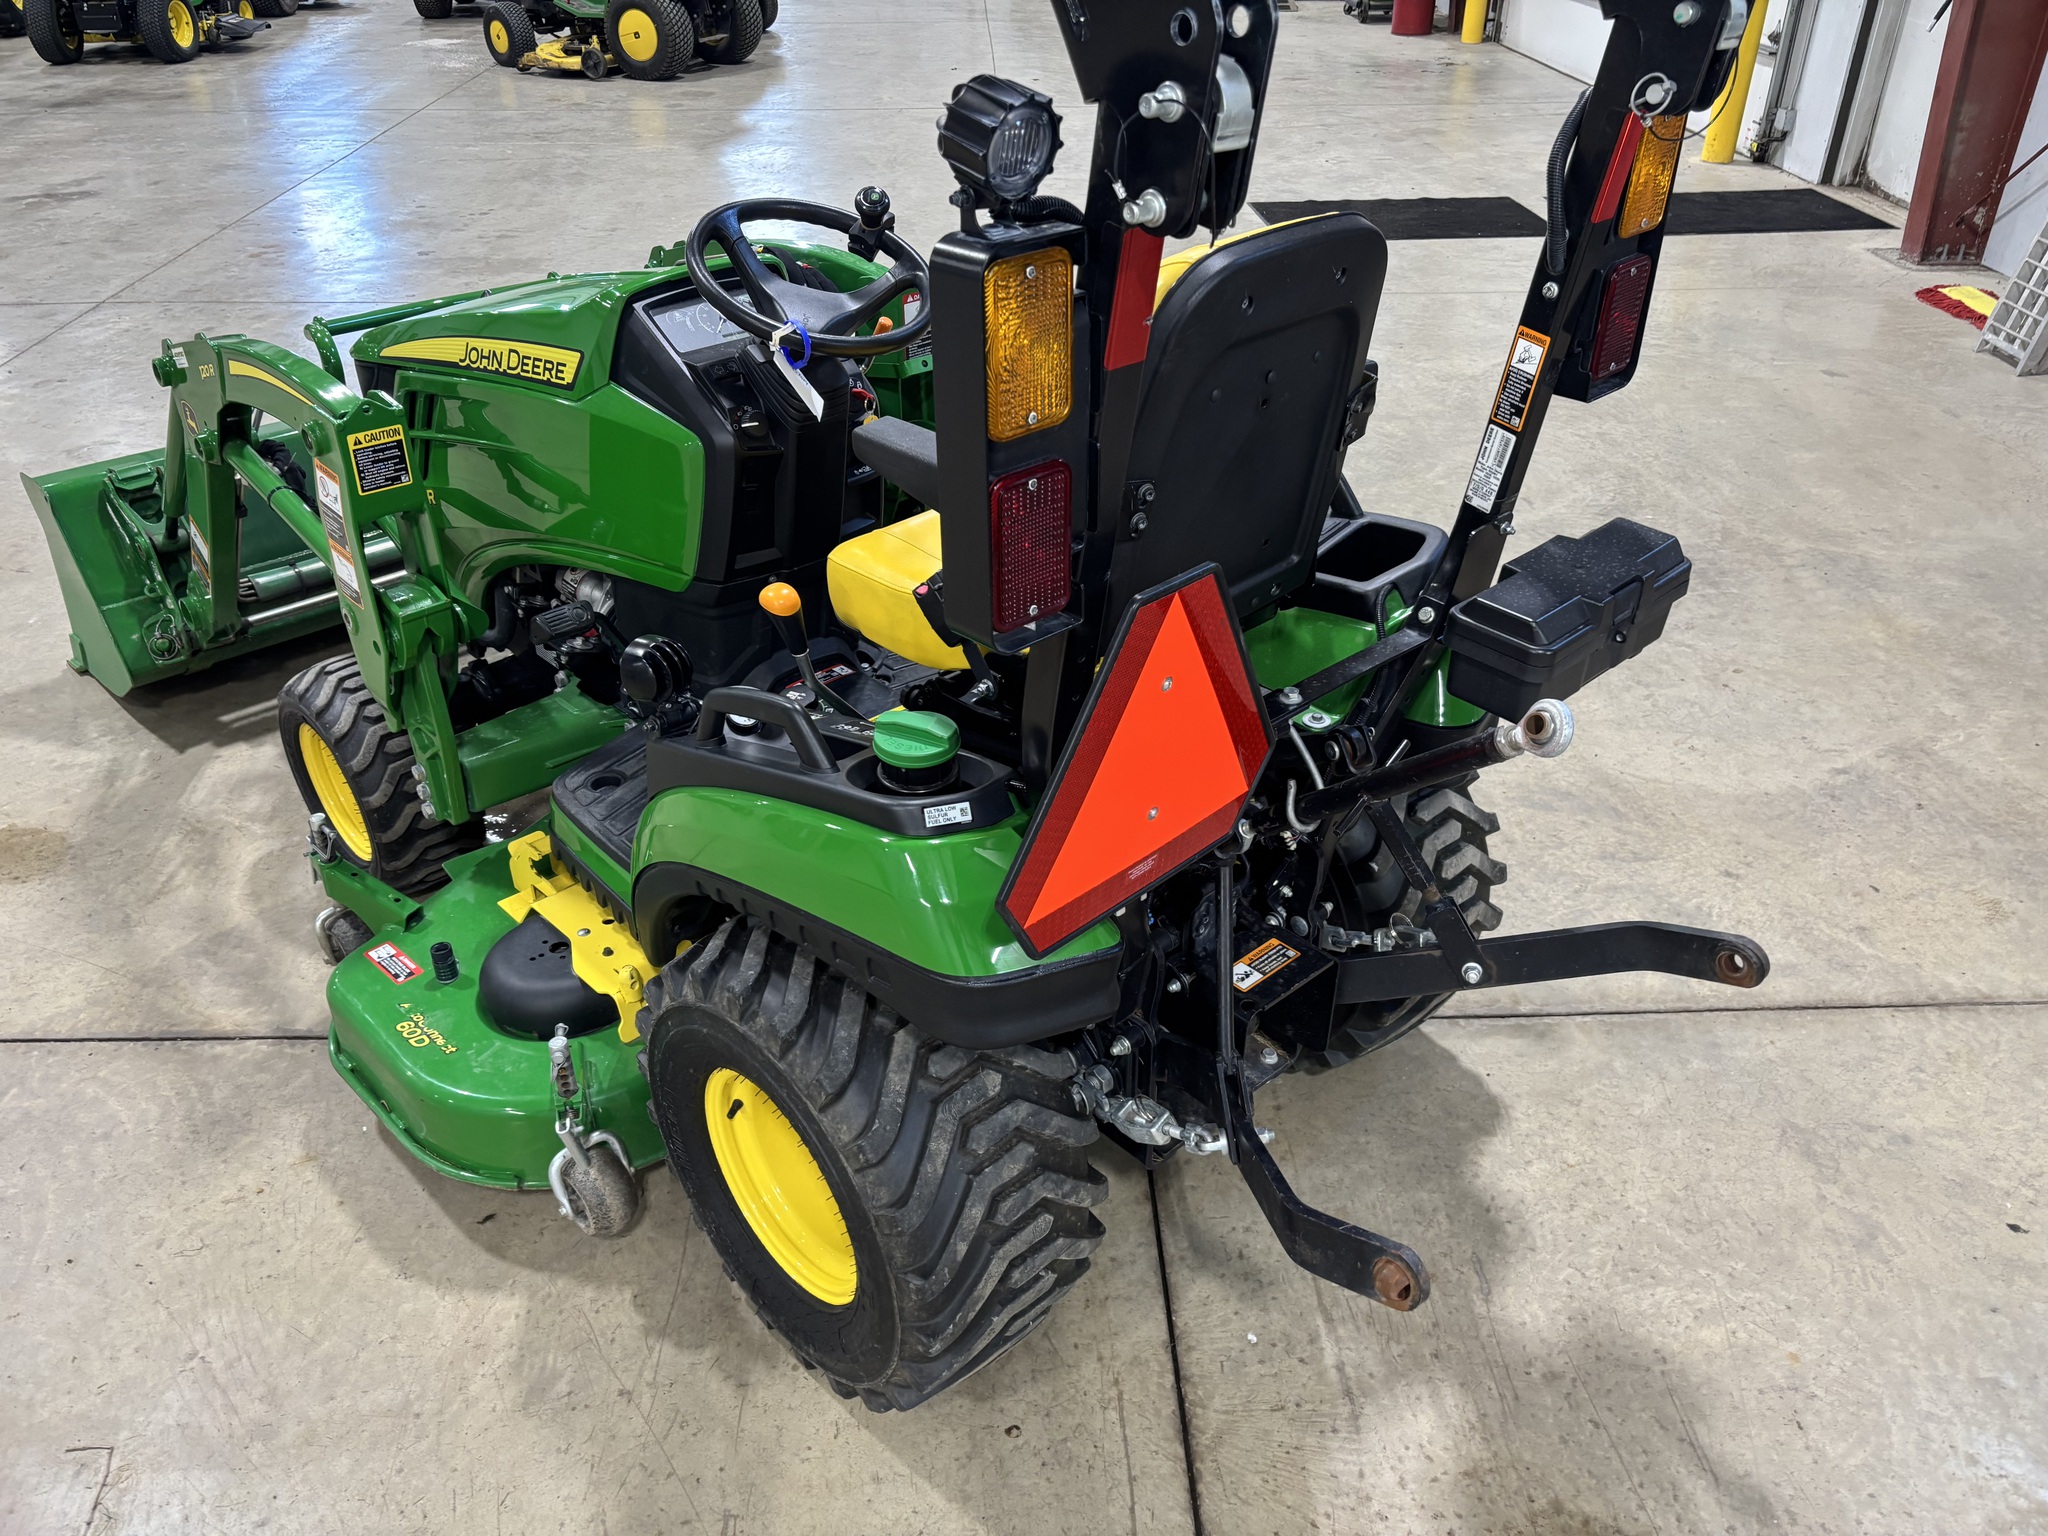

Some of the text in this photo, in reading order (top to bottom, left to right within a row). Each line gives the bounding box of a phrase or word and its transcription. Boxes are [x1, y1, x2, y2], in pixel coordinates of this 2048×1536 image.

[1524, 331, 1547, 346] WARNING
[459, 342, 567, 382] JOHN DEERE
[364, 427, 401, 443] CAUTION
[884, 737, 929, 752] DIESEL
[395, 1021, 430, 1047] 60D
